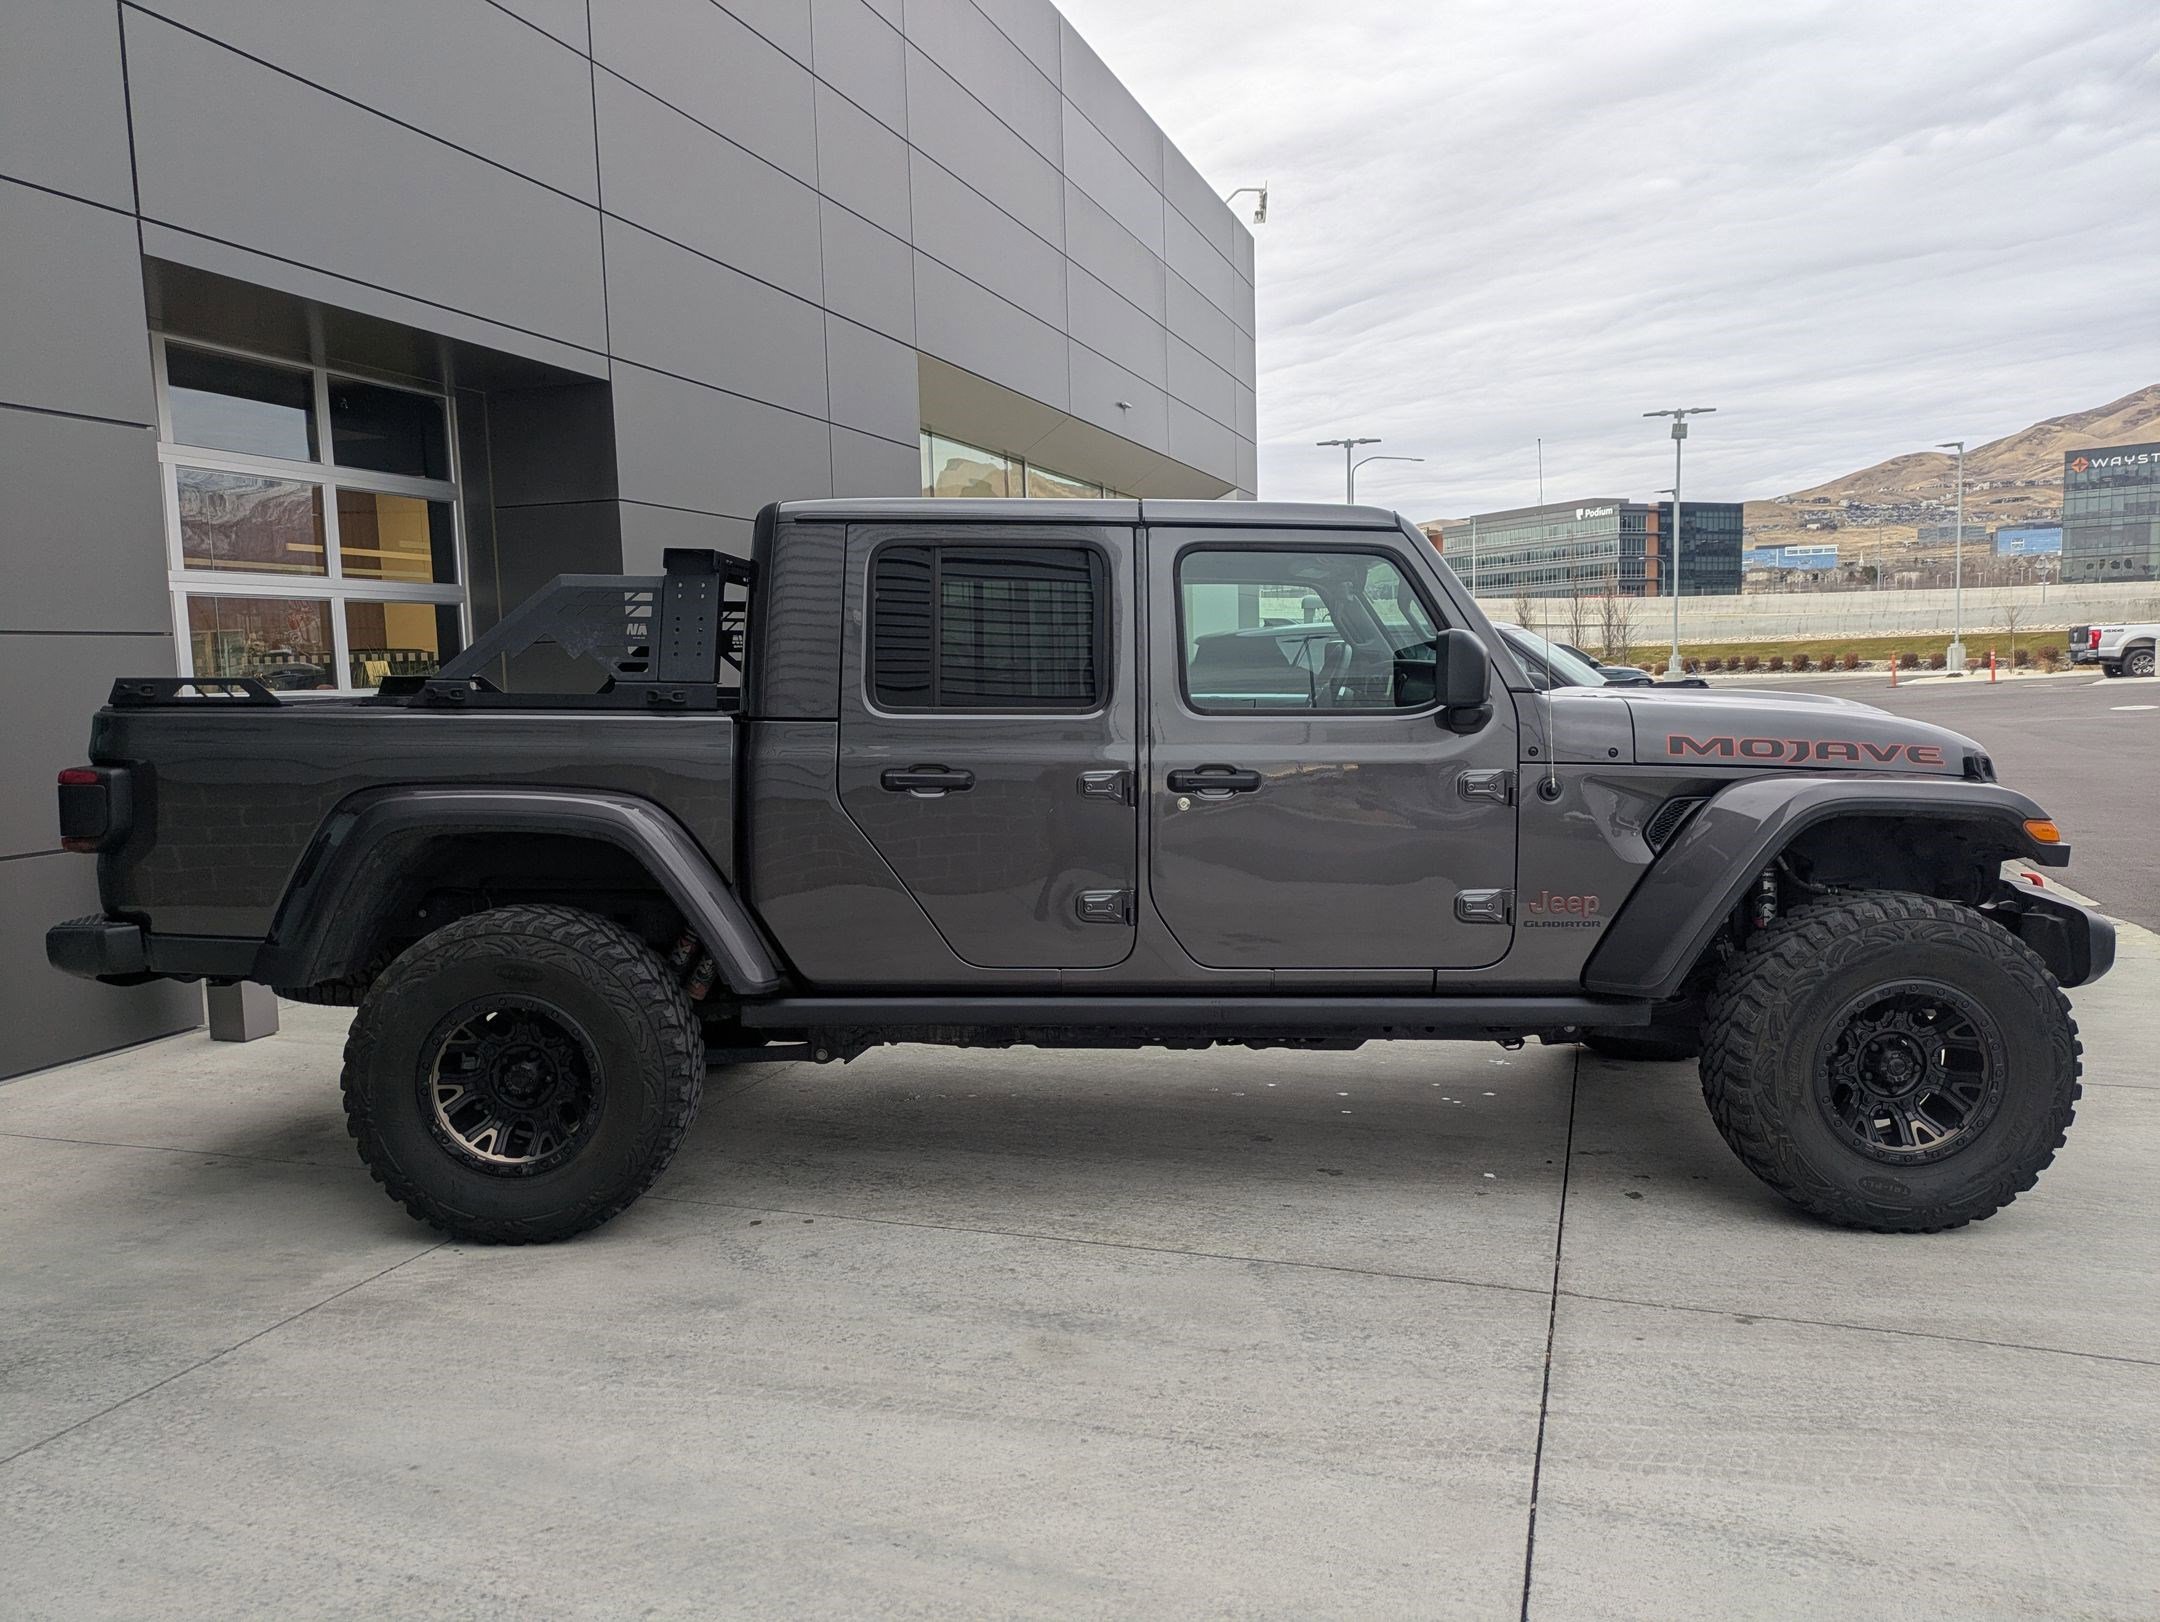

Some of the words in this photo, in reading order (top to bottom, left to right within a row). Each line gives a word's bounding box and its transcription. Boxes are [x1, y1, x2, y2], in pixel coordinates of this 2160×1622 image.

[2091, 452, 2160, 468] WAYST
[1585, 506, 1613, 518] Podium
[1667, 735, 1945, 767] MOJAVE
[1528, 890, 1600, 919] Jeep
[1523, 920, 1601, 928] GLADIATOR
